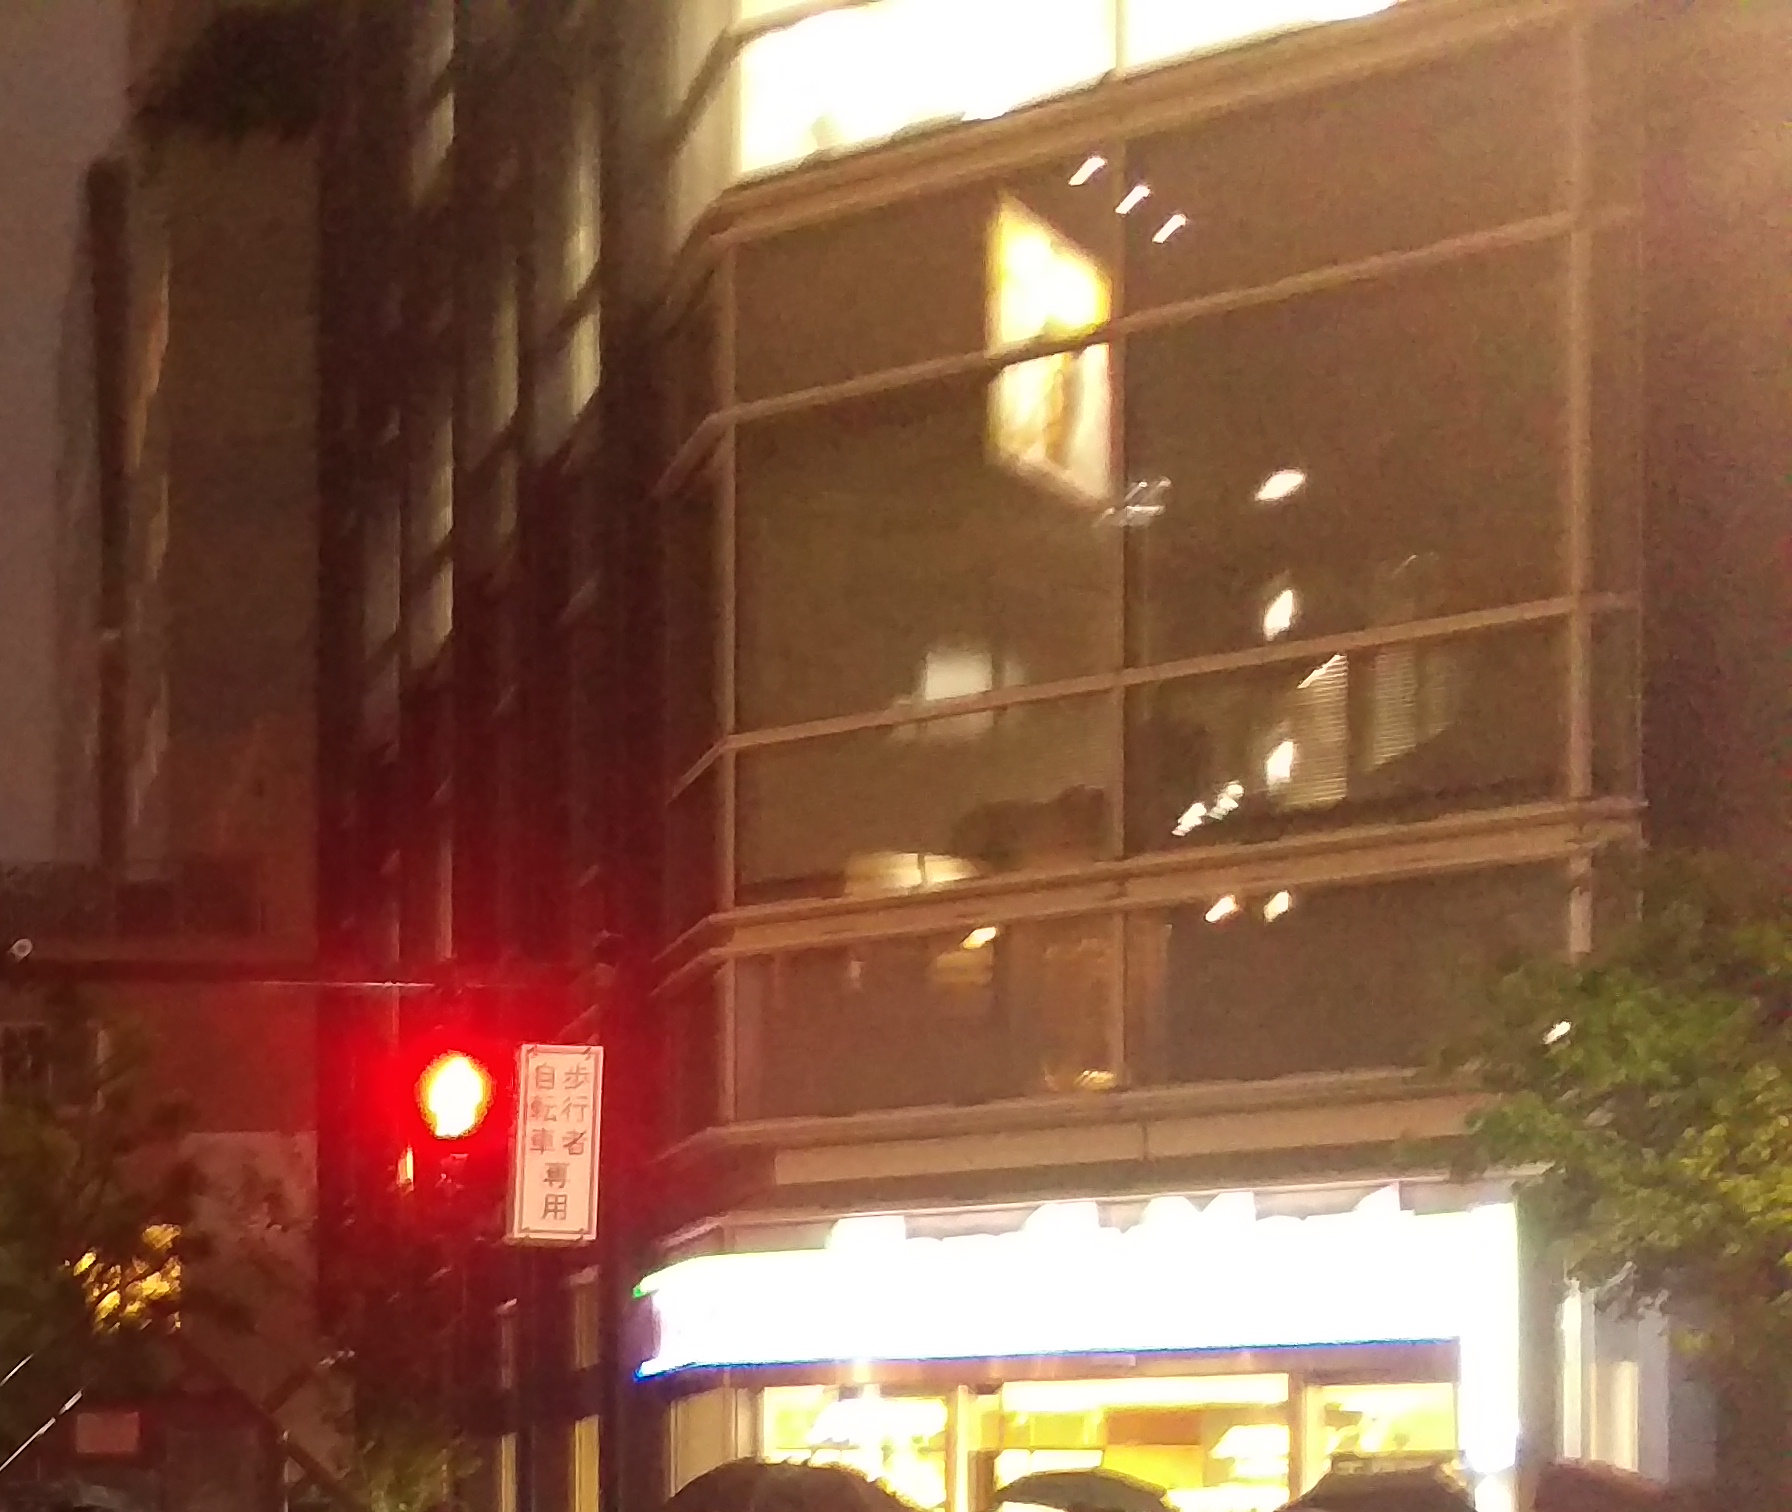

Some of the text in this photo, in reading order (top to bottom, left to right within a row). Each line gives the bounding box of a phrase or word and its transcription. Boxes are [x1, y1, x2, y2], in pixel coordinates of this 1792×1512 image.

[529, 1061, 557, 1155] 自転車
[561, 1061, 590, 1156] 歩行者
[541, 1162, 570, 1221] 専用
